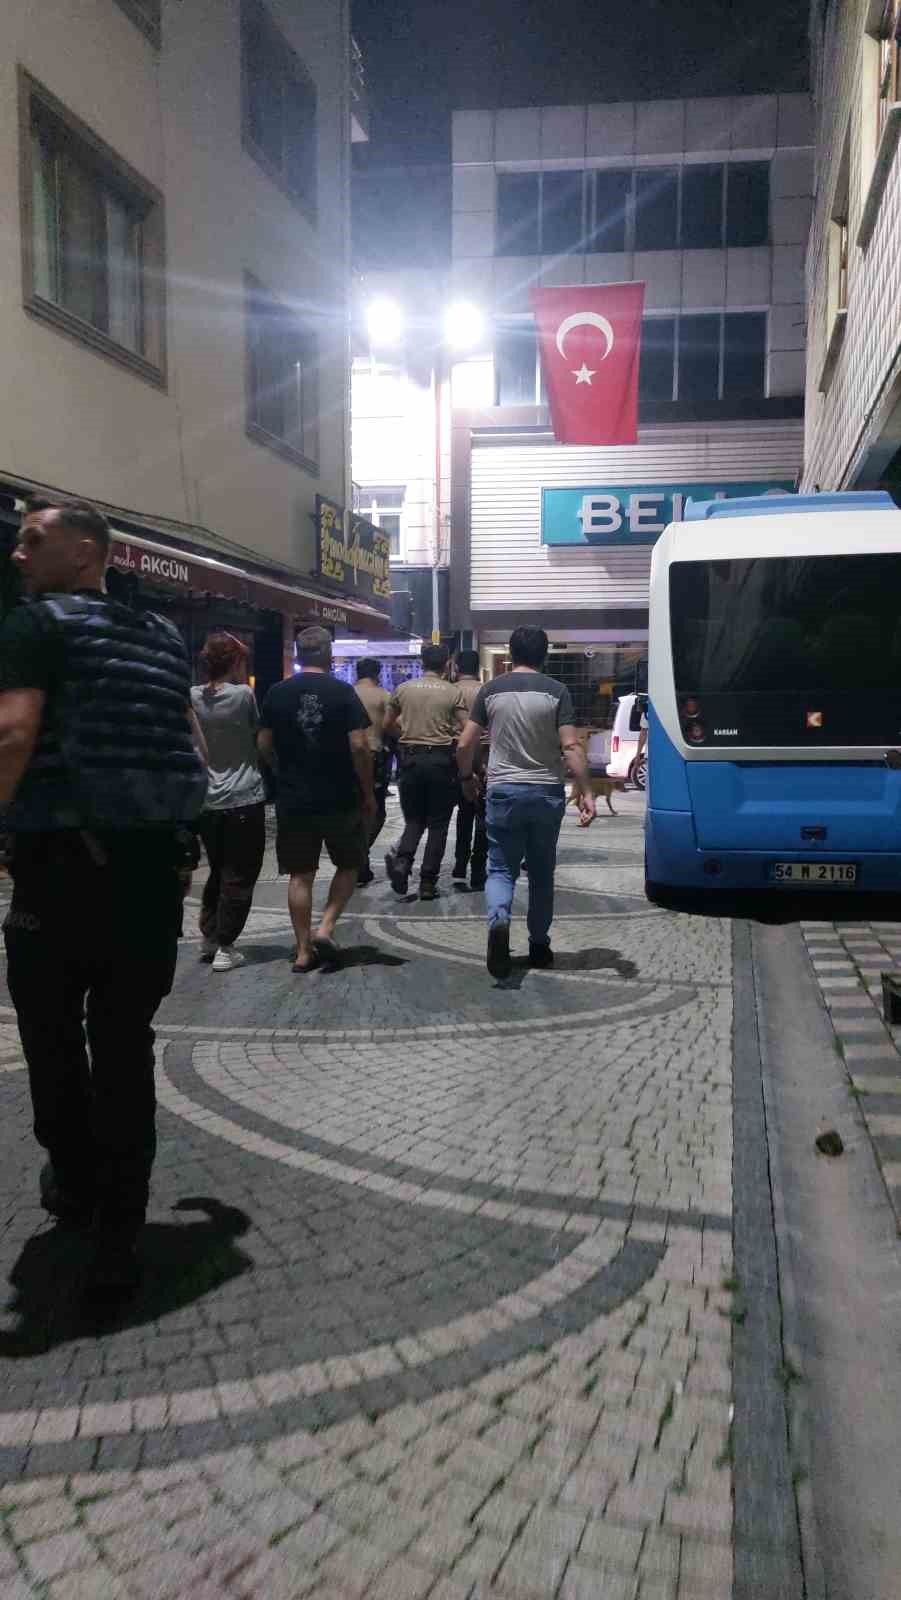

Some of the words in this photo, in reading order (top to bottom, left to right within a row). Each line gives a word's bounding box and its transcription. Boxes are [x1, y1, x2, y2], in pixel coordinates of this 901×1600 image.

[141, 554, 189, 582] AKGÜN
[775, 865, 792, 878] 54
[818, 865, 855, 879] 2116
